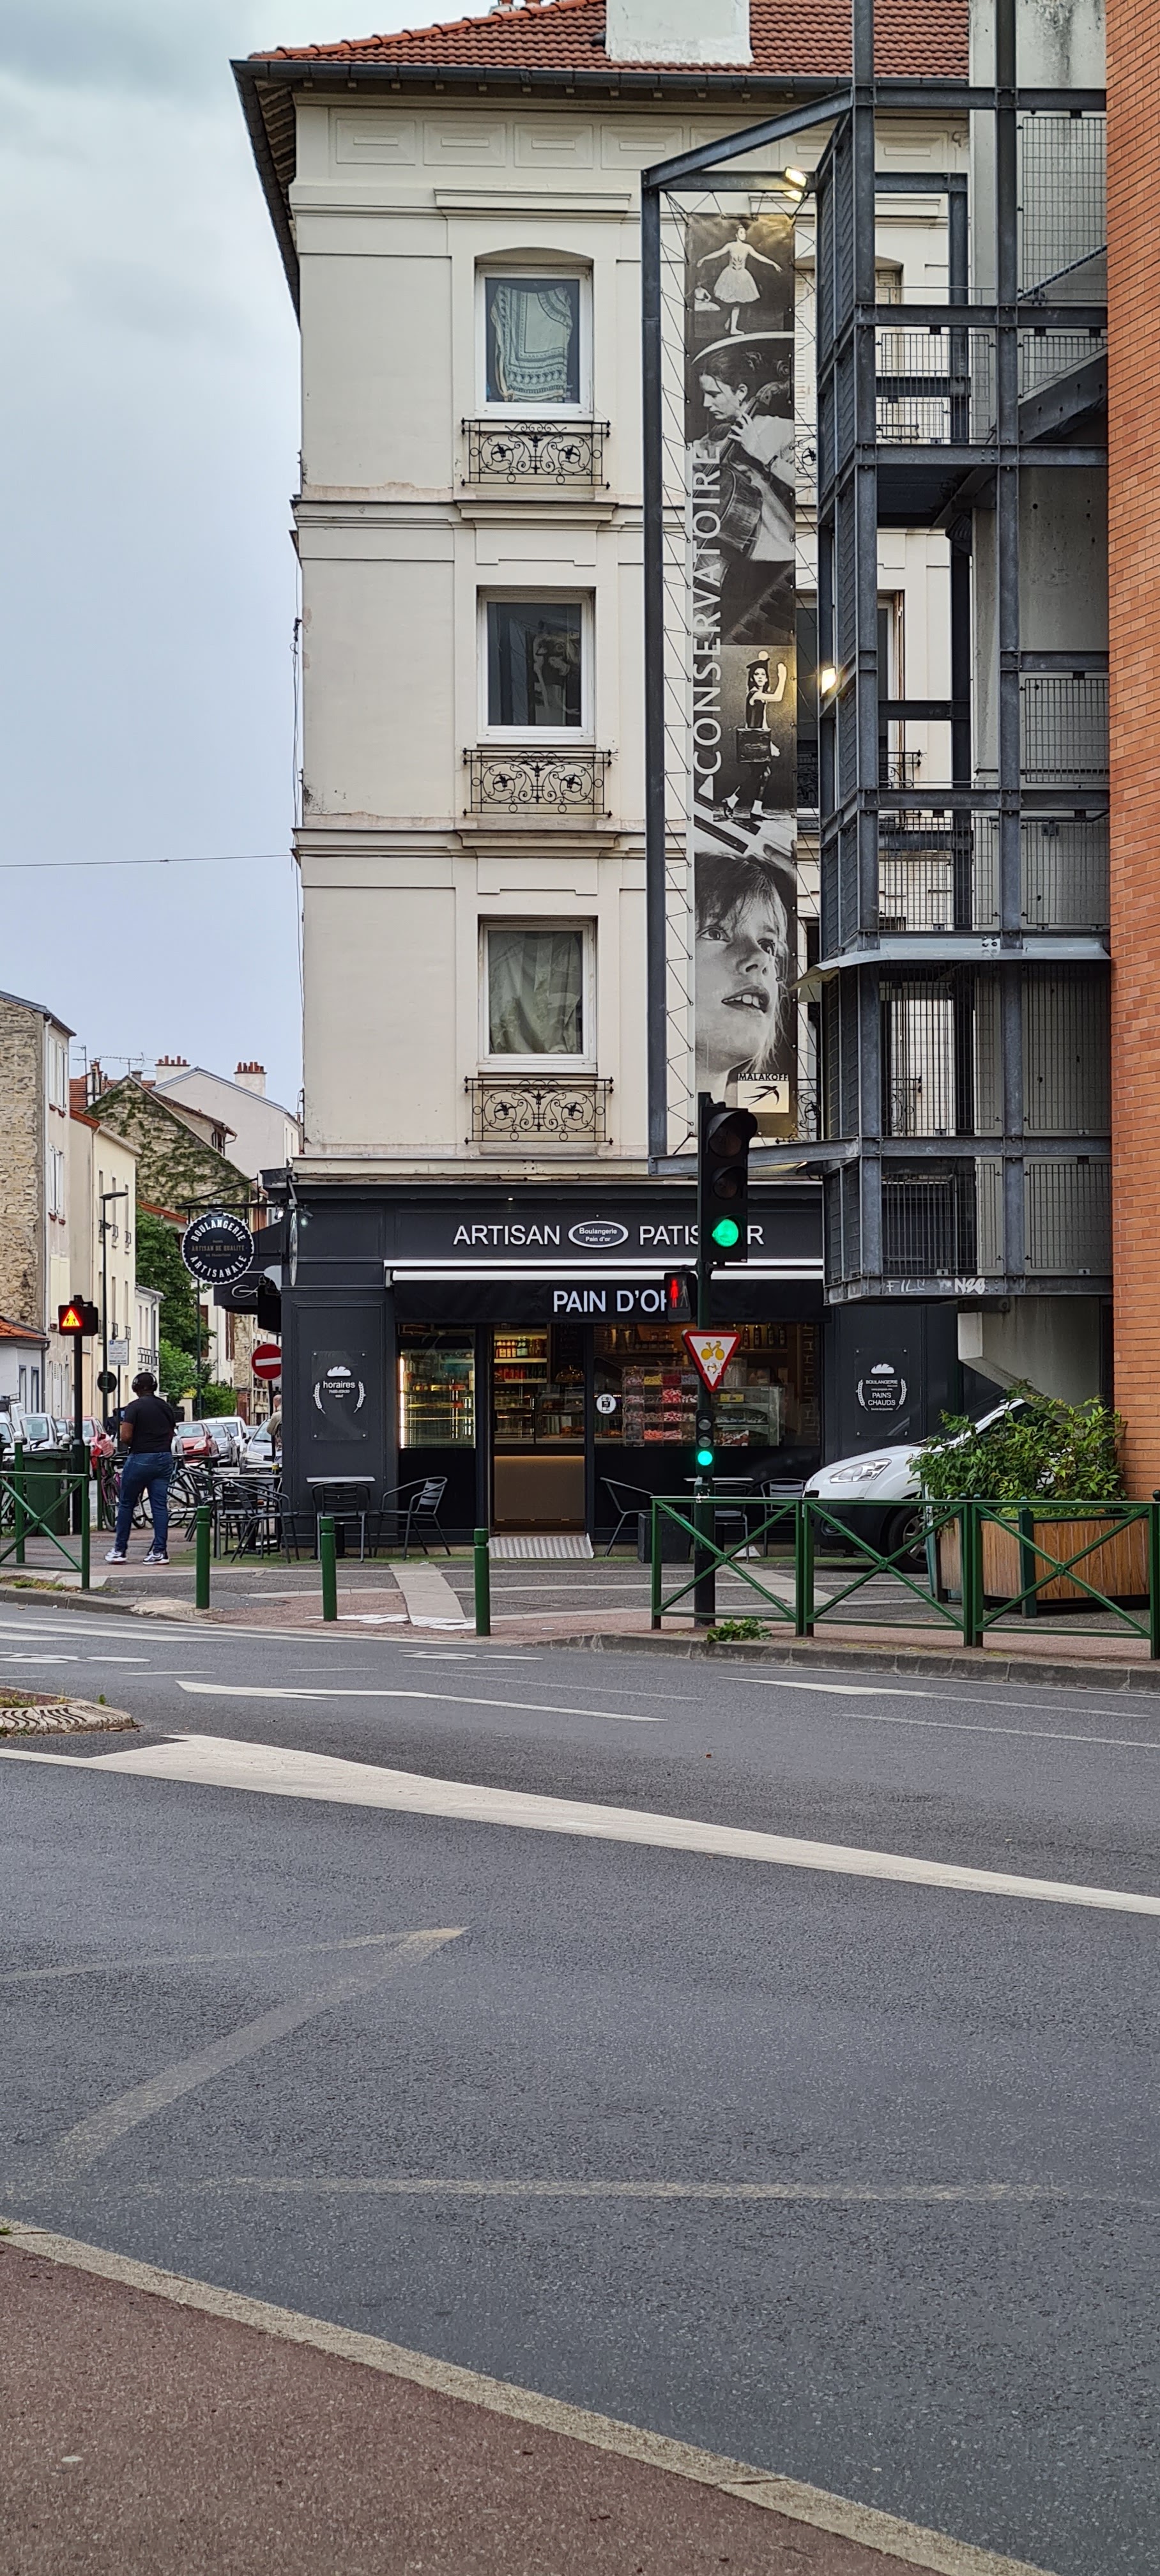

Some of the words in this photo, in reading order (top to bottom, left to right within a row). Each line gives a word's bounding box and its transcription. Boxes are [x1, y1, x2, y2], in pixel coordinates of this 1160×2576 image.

[692, 446, 721, 775] CONSERVATOIRE
[738, 1073, 789, 1081] MALAKOFF
[190, 1219, 246, 1242] BOULANGERIE
[453, 1225, 560, 1245] ARTISAN
[639, 1225, 765, 1245] PATISR
[579, 1227, 617, 1236] Boulangerie
[190, 1255, 247, 1278] ARTISANALE
[553, 1291, 606, 1312] PAIN
